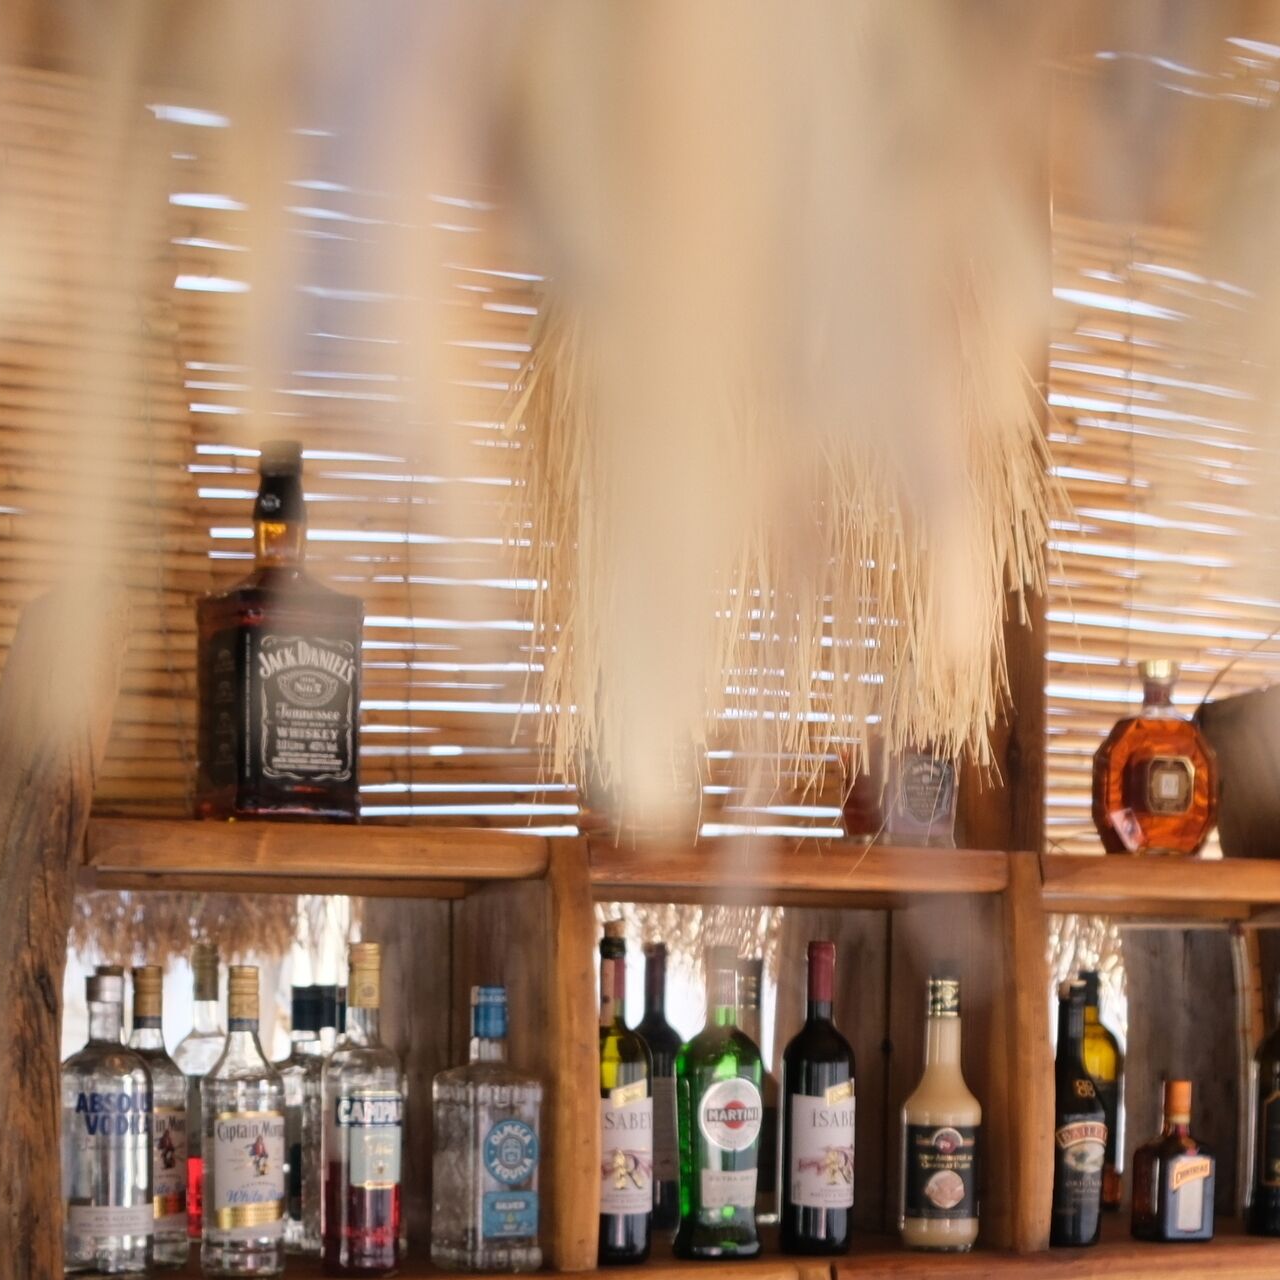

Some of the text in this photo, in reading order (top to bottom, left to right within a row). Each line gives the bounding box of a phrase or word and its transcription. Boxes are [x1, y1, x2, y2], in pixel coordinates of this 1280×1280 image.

[258, 647, 298, 679] JACK
[706, 1108, 759, 1122] MARTINI
[217, 1121, 259, 1143] Captain
[491, 1124, 532, 1145] OLMECA
[490, 1158, 533, 1180] TEQUILA
